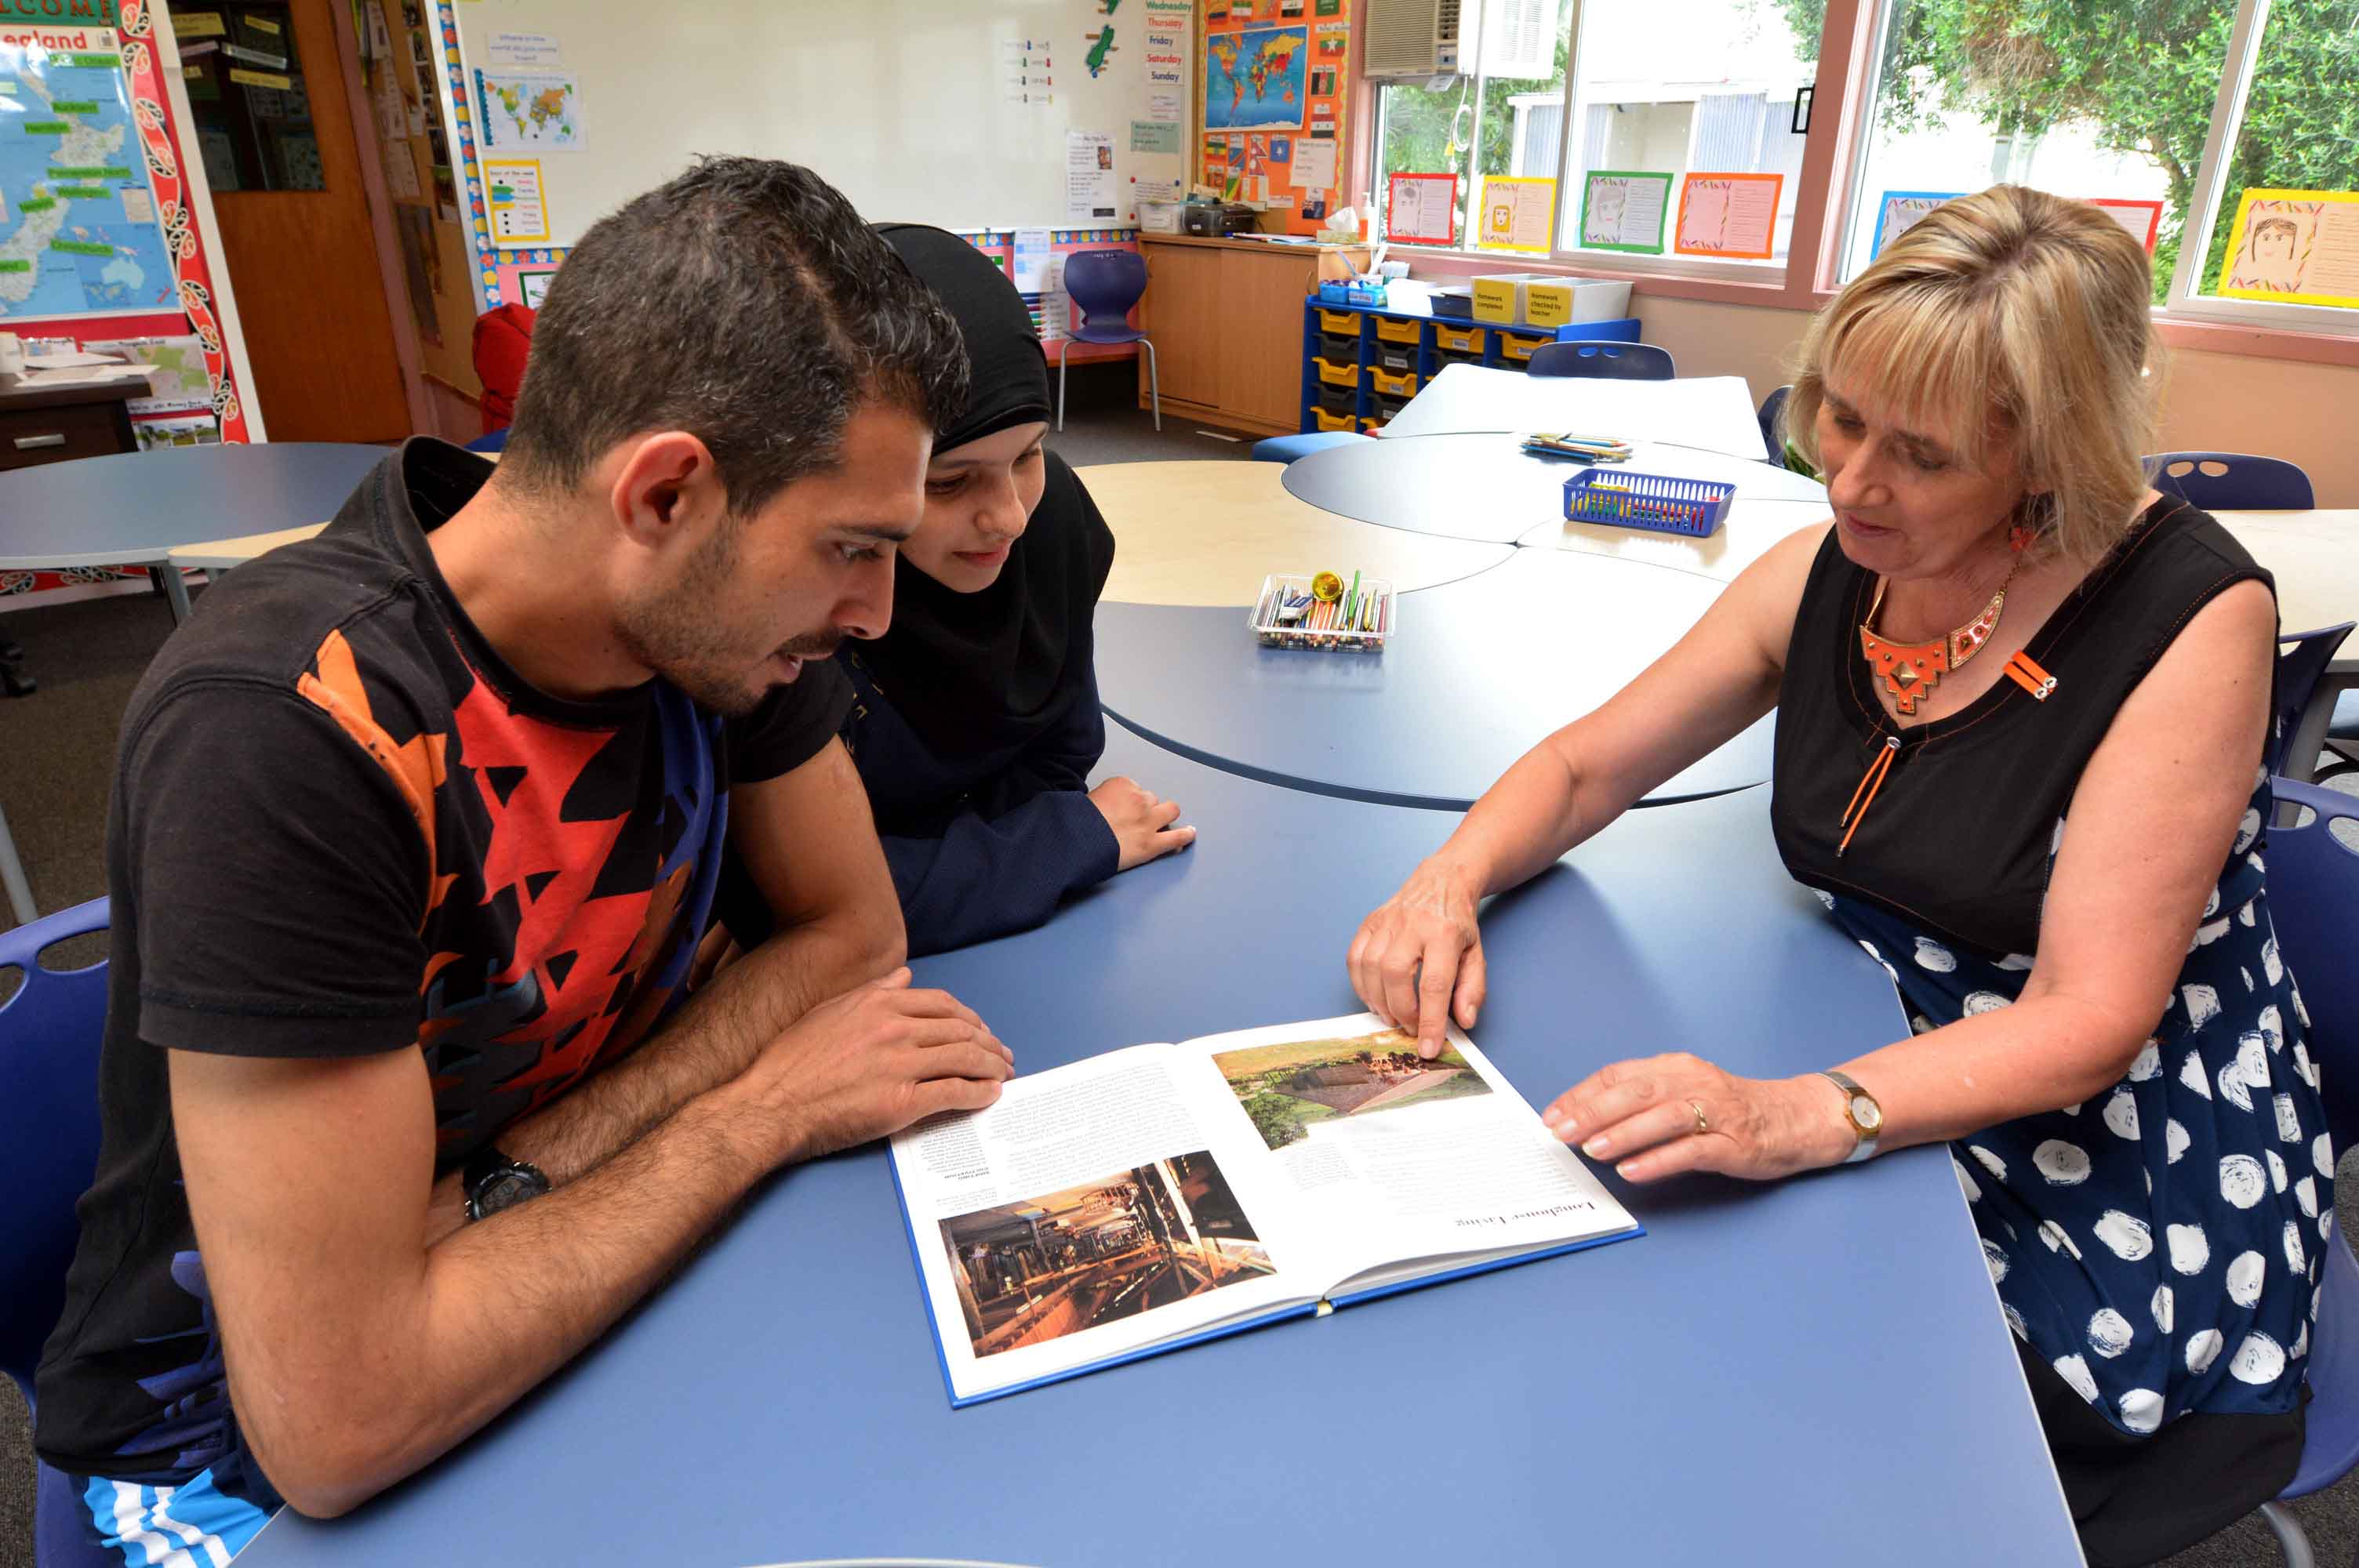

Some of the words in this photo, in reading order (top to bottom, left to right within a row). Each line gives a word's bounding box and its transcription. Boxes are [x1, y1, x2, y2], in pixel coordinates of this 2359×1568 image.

[1146, 1, 1192, 13] Wednesday
[1148, 17, 1183, 30] Thursday
[1150, 35, 1173, 47] Friday
[1147, 53, 1182, 66] Saturday
[1151, 71, 1180, 83] Sunday
[1532, 291, 1558, 302] Homework
[1477, 301, 1503, 311] completed
[1531, 300, 1554, 310] checked
[1555, 303, 1562, 312] by
[1531, 308, 1550, 318] teacher
[1511, 1201, 1595, 1220] Longhouse
[1456, 1216, 1507, 1228] Living
